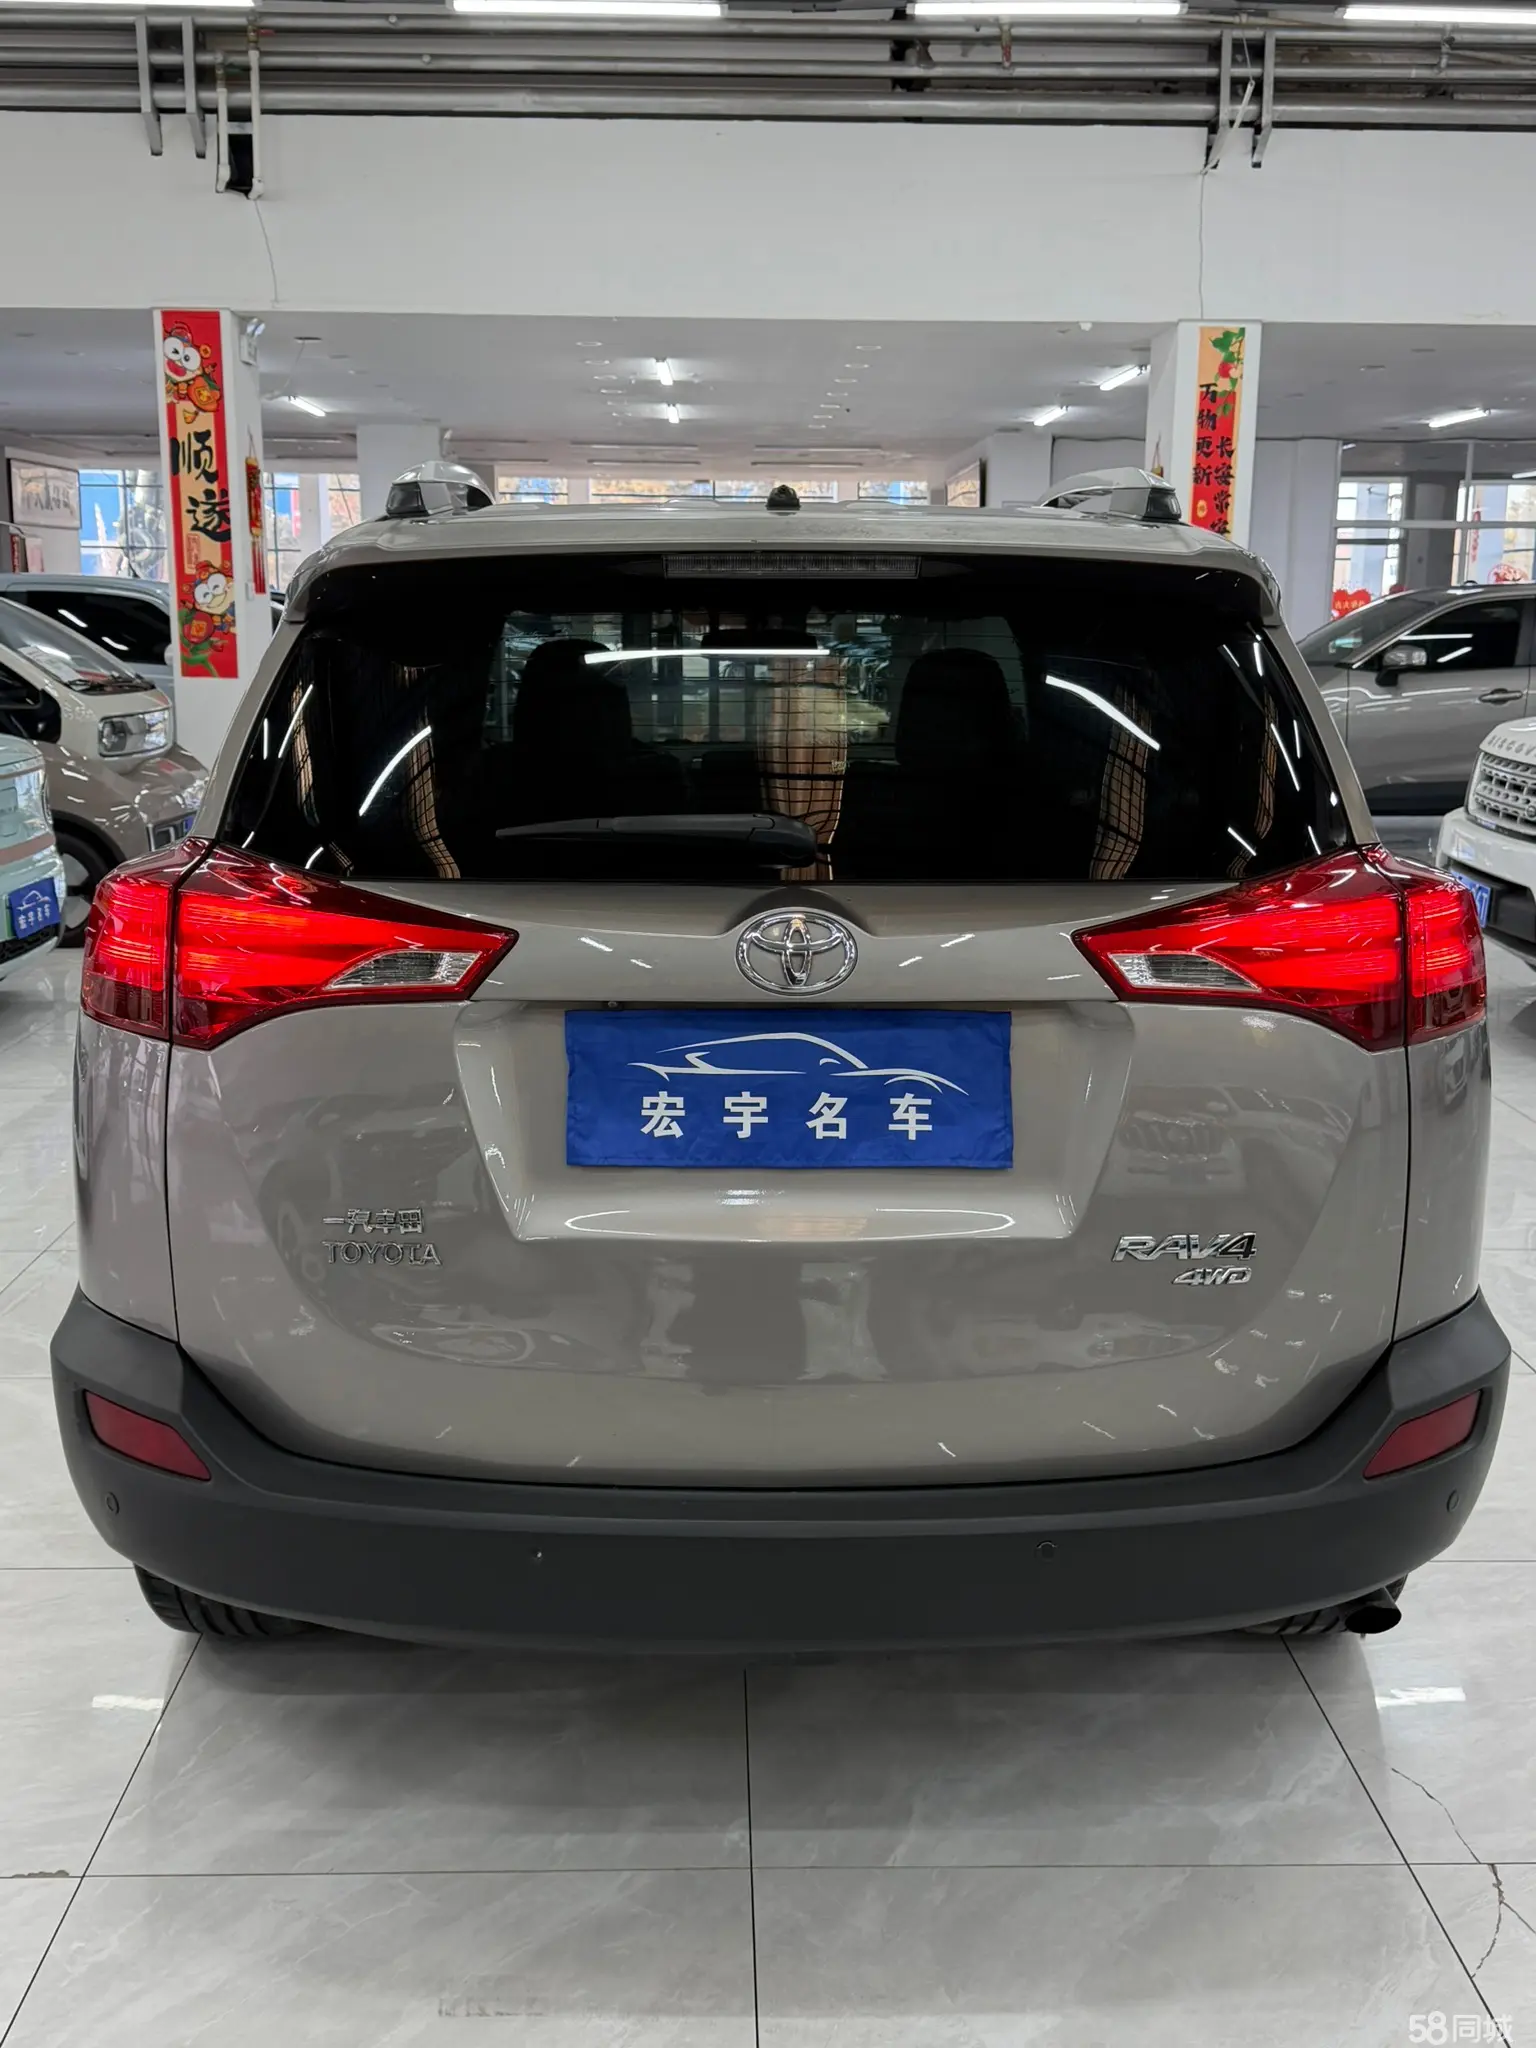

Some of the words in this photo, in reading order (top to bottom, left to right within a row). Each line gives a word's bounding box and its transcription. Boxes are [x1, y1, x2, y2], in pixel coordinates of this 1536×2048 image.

[1192, 382, 1218, 486] 万物更新
[169, 428, 231, 543] 顺遂
[640, 1090, 933, 1141] 宏宇名车
[322, 1208, 423, 1234] 一汽丰田
[322, 1241, 442, 1265] TOYOTA
[1112, 1232, 1257, 1261] RAV4
[1172, 1266, 1252, 1286] 4WD
